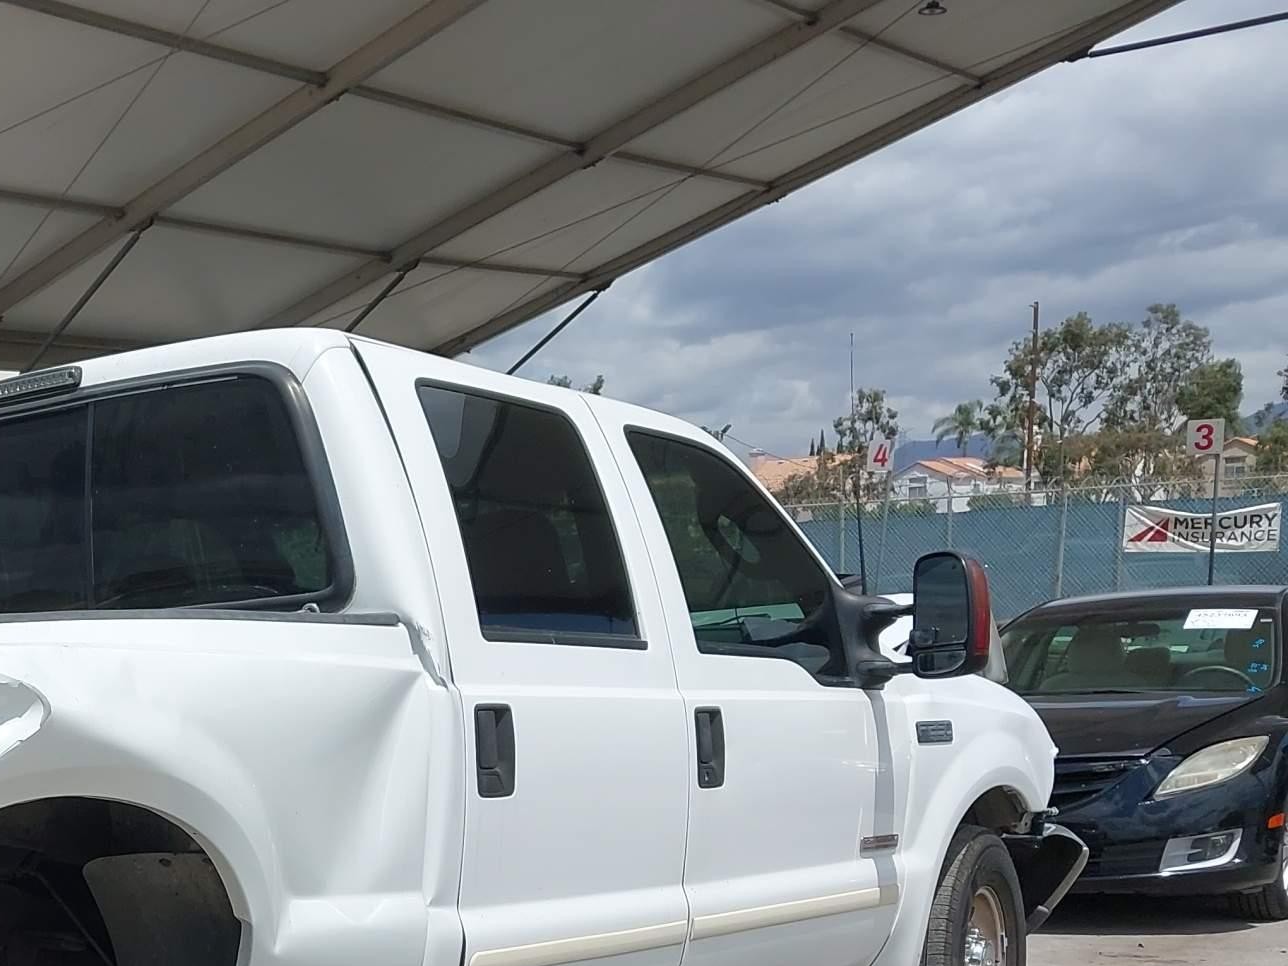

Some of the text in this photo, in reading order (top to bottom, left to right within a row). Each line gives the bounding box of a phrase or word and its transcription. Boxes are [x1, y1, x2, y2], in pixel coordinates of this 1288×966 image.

[1194, 423, 1214, 450] 3
[873, 443, 888, 467] 4
[1173, 513, 1277, 530] MERCURY
[1172, 529, 1278, 543] INSURANCE
